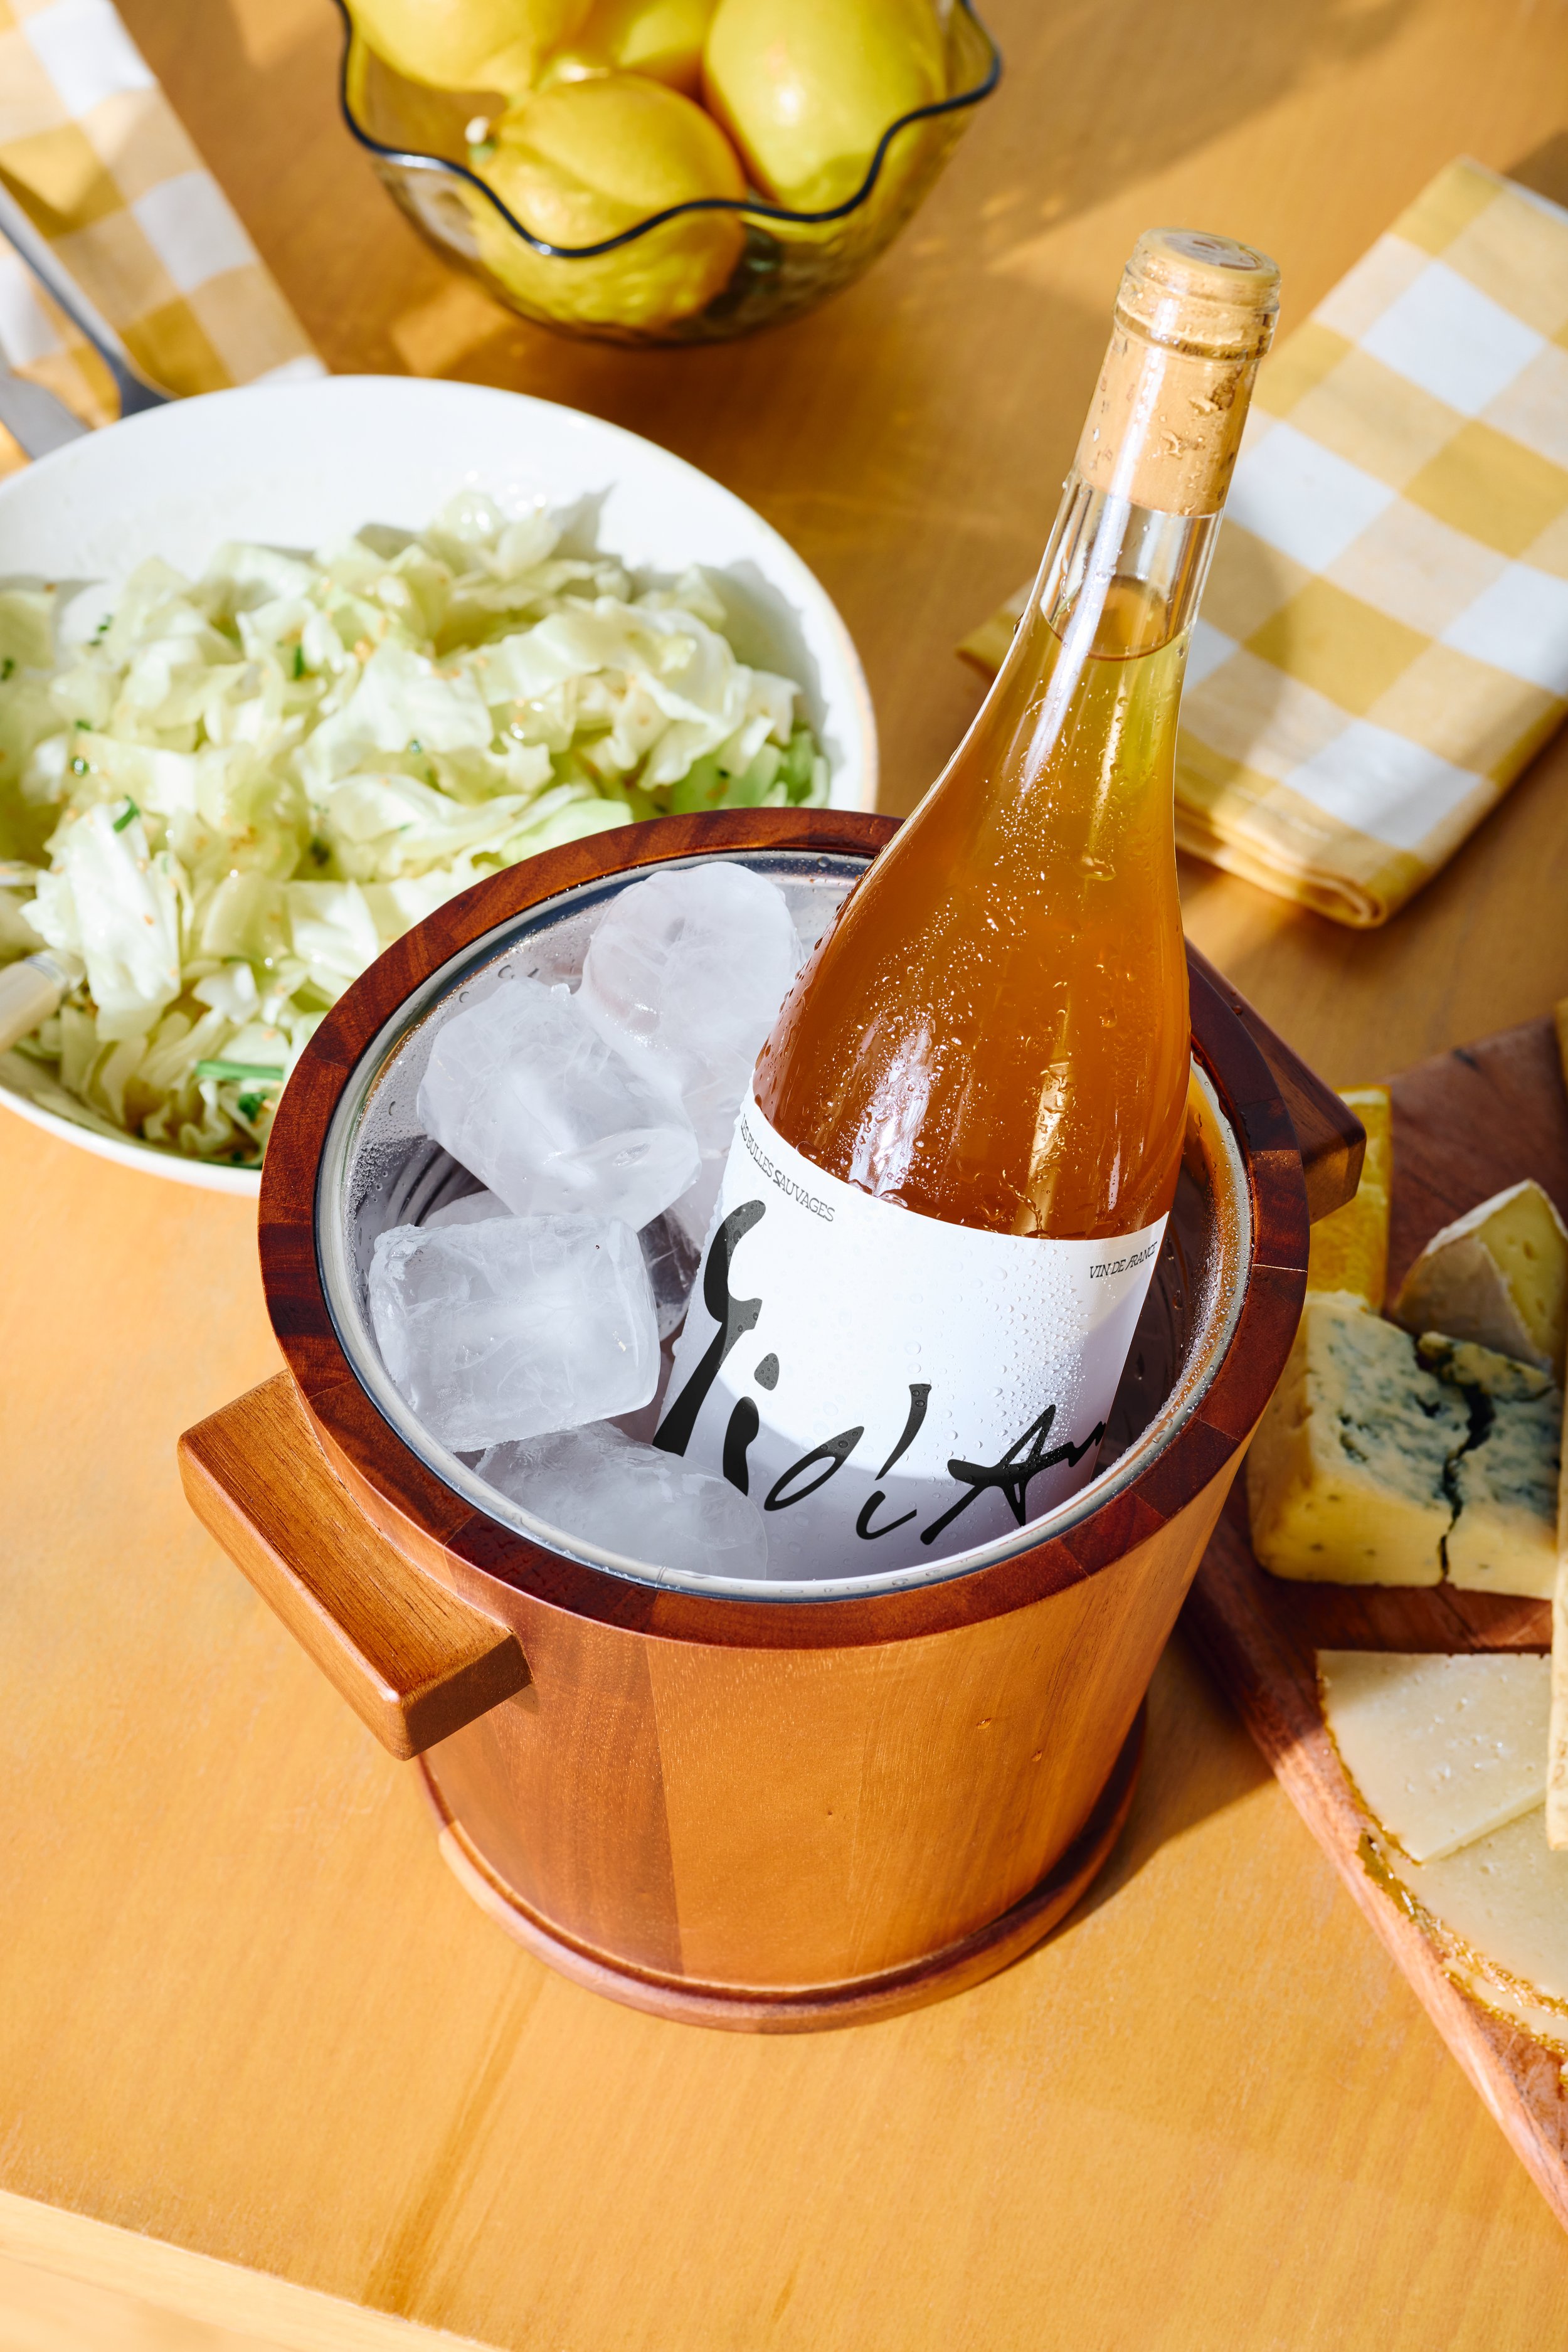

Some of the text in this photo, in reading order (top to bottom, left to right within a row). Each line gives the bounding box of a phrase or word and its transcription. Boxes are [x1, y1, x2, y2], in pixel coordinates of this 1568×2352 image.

[741, 1113, 835, 1222] LES BULLES SAUVAGES
[1089, 1241, 1158, 1279] VIN DE FRANCE
